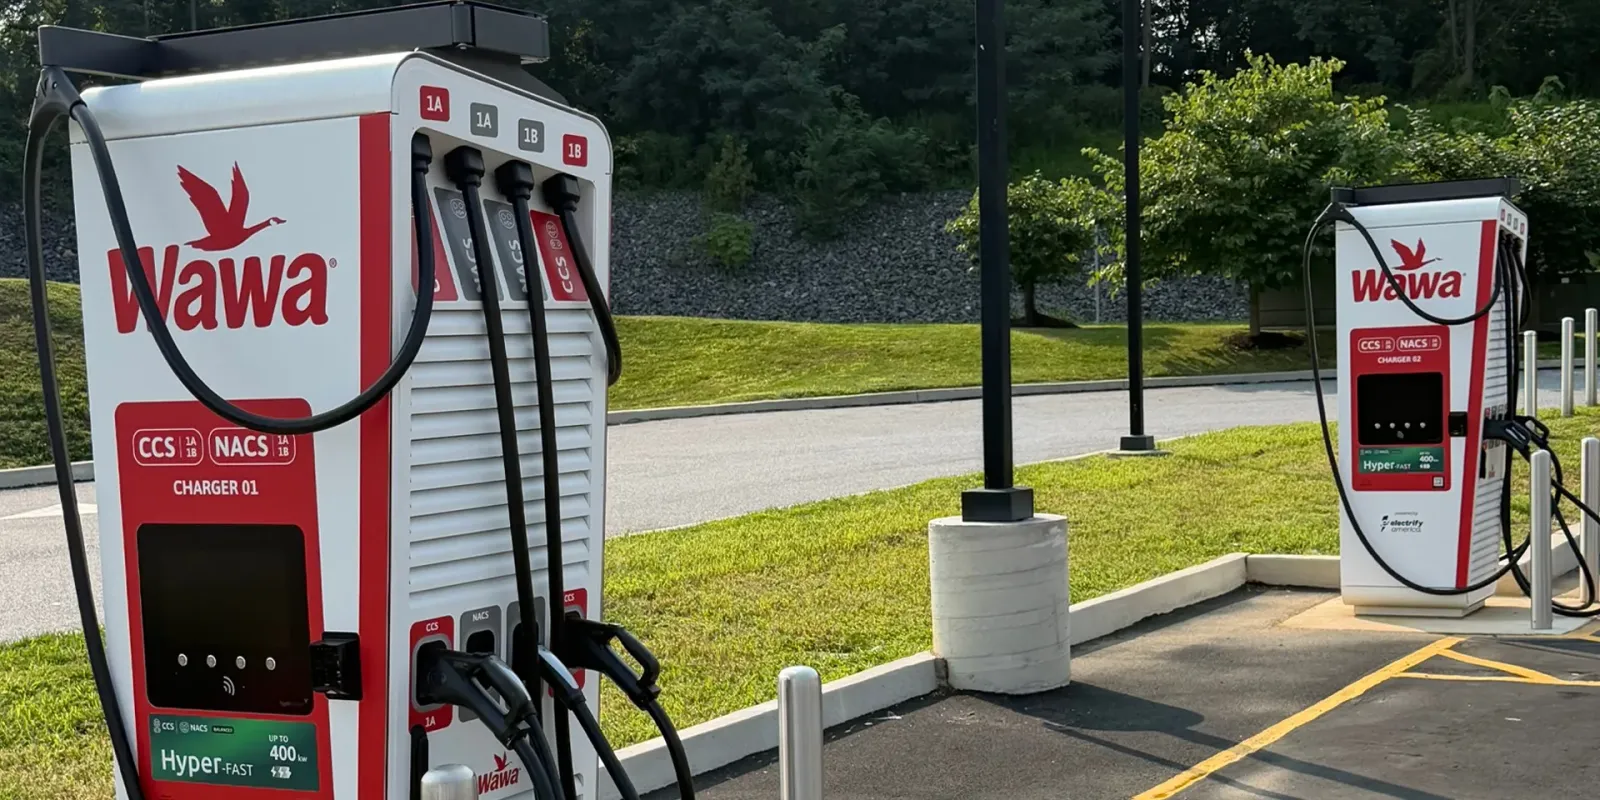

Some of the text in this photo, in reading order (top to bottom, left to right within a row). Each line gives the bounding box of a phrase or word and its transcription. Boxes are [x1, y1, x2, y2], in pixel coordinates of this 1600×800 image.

[426, 95, 443, 113] 1A
[476, 112, 492, 129] 1A
[524, 127, 539, 144] 1B
[568, 143, 582, 158] 1B
[556, 256, 574, 294] CCS
[1351, 269, 1461, 302] Wawa
[1361, 341, 1381, 350] CCS
[1400, 339, 1428, 349] NACS
[1377, 356, 1411, 364] CHARGER
[185, 436, 197, 446] 1A
[277, 435, 290, 445] 1A
[138, 435, 269, 458] CCS NACS
[278, 447, 290, 457] 1B
[186, 448, 197, 458] 1B
[1363, 460, 1411, 471] Hyper-FAST
[173, 480, 259, 495] CHARGER 01
[1390, 520, 1424, 528] electrify
[564, 593, 575, 603] CCS
[472, 610, 489, 621] NACS
[425, 622, 439, 632] CCS
[425, 715, 436, 727] 1A
[161, 722, 208, 733] CCS NACS
[268, 734, 289, 743] UP TO
[269, 745, 296, 762] 400
[161, 749, 254, 777] Hyper-FAST
[478, 770, 519, 794] Wawa
